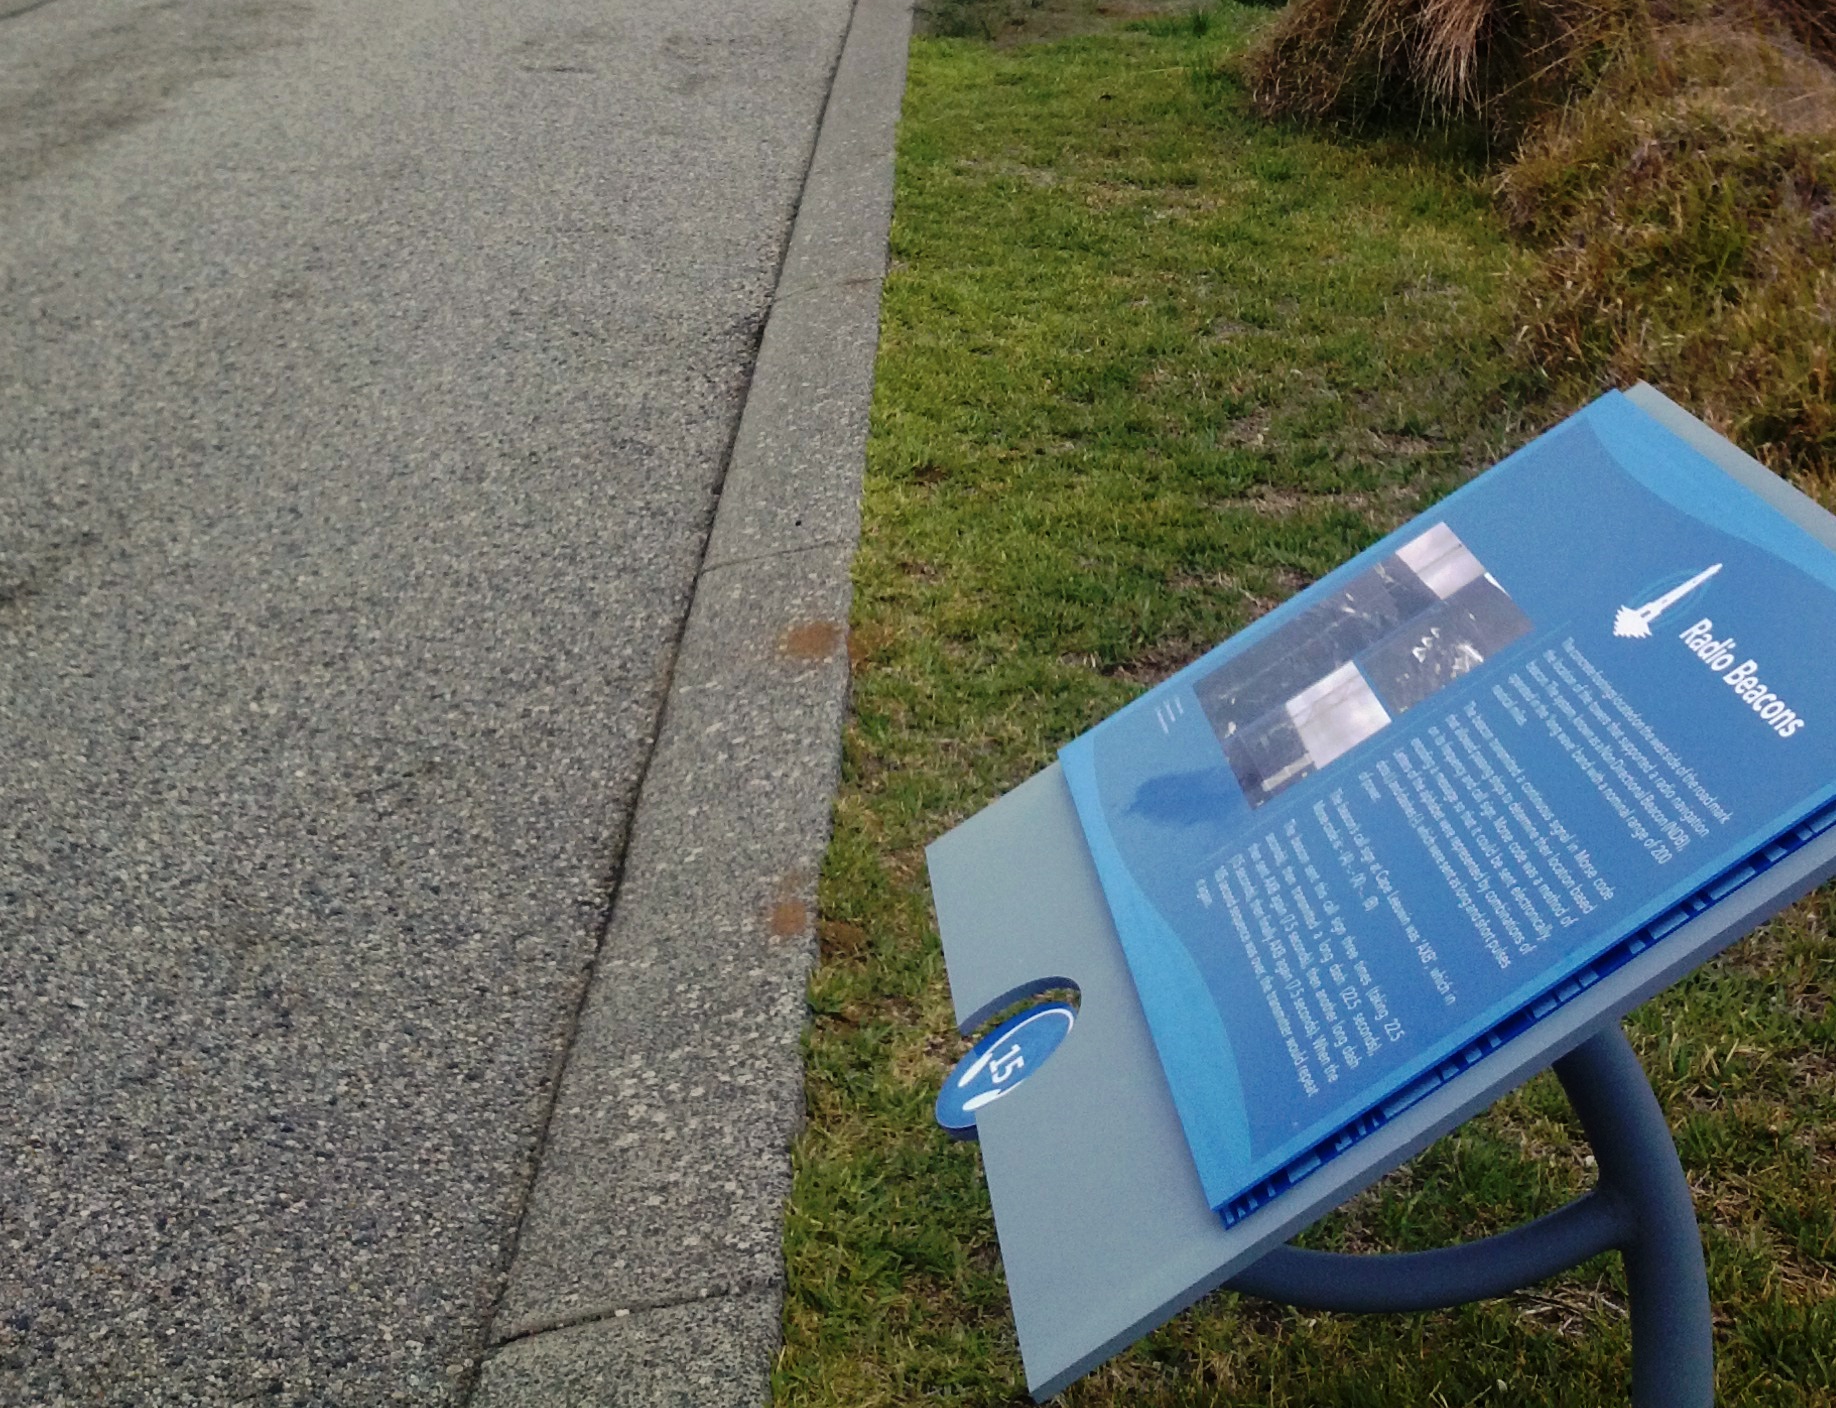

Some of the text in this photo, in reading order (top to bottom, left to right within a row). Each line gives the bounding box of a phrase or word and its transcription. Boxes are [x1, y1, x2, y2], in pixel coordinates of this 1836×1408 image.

[1679, 618, 1804, 738] Radio Beacons
[1630, 717, 1646, 731] on
[1638, 723, 1659, 741] the
[1647, 734, 1672, 756] west
[1661, 749, 1685, 770] side
[1673, 763, 1691, 777] of
[1584, 764, 1608, 785] with
[1614, 733, 1658, 776] supported
[1652, 774, 1680, 799] radio
[1666, 793, 1714, 840] navigation
[1680, 770, 1703, 790] the
[1601, 784, 1635, 819] nominal
[1608, 758, 1650, 800] Directional
[1638, 793, 1672, 827] Beacon
[1657, 819, 1693, 854] (NDB),
[1690, 782, 1718, 806] road
[1705, 798, 1734, 824] mark
[1544, 816, 1575, 846] signal
[1620, 814, 1650, 843] range
[1642, 834, 1661, 850] of
[1474, 831, 1499, 858] could
[1565, 839, 1582, 854] in
[1649, 843, 1673, 865] 200
[1438, 858, 1460, 881] sent
[1488, 852, 1507, 870] be
[1490, 815, 1517, 844] Morse
[1506, 838, 1531, 864] code
[1520, 860, 1539, 879] was
[1536, 880, 1569, 918] method
[1558, 912, 1577, 929] of
[1532, 834, 1556, 858] their
[1545, 852, 1579, 889] location
[1568, 883, 1598, 915] based
[1572, 848, 1601, 879] Morse
[1448, 876, 1462, 889] as
[1472, 875, 1495, 895] by
[1496, 864, 1519, 888] sent
[1591, 874, 1618, 902] code
[1449, 882, 1476, 909] long
[1464, 900, 1486, 922] and
[1483, 886, 1529, 946] combinations
[1505, 883, 1555, 945] electronically.
[1370, 868, 1397, 897] Cape
[1404, 923, 1421, 943] was
[1428, 963, 1454, 995] which
[1443, 989, 1460, 1006] in
[1474, 916, 1499, 943] short
[1313, 937, 1337, 965] long
[1482, 935, 1515, 972] pulses
[1517, 939, 1536, 956] of
[1271, 954, 1297, 985] again
[1327, 960, 1349, 986] dash
[1335, 984, 1361, 1014] (22.5
[1340, 933, 1362, 961] three
[1361, 984, 1392, 1023] (taking
[1382, 1017, 1404, 1044] 22.5
[1289, 993, 1322, 1042] seconds).
[1314, 985, 1342, 1024] another
[1326, 1018, 1352, 1049] long
[1347, 1009, 1383, 1059] seconds),
[1284, 1033, 1308, 1066] would
[1310, 1033, 1335, 1067] When
[1340, 1041, 1364, 1070] dash
[989, 1044, 1024, 1084] 15
[1322, 1061, 1342, 1084] the
[1292, 1061, 1322, 1101] repeat
